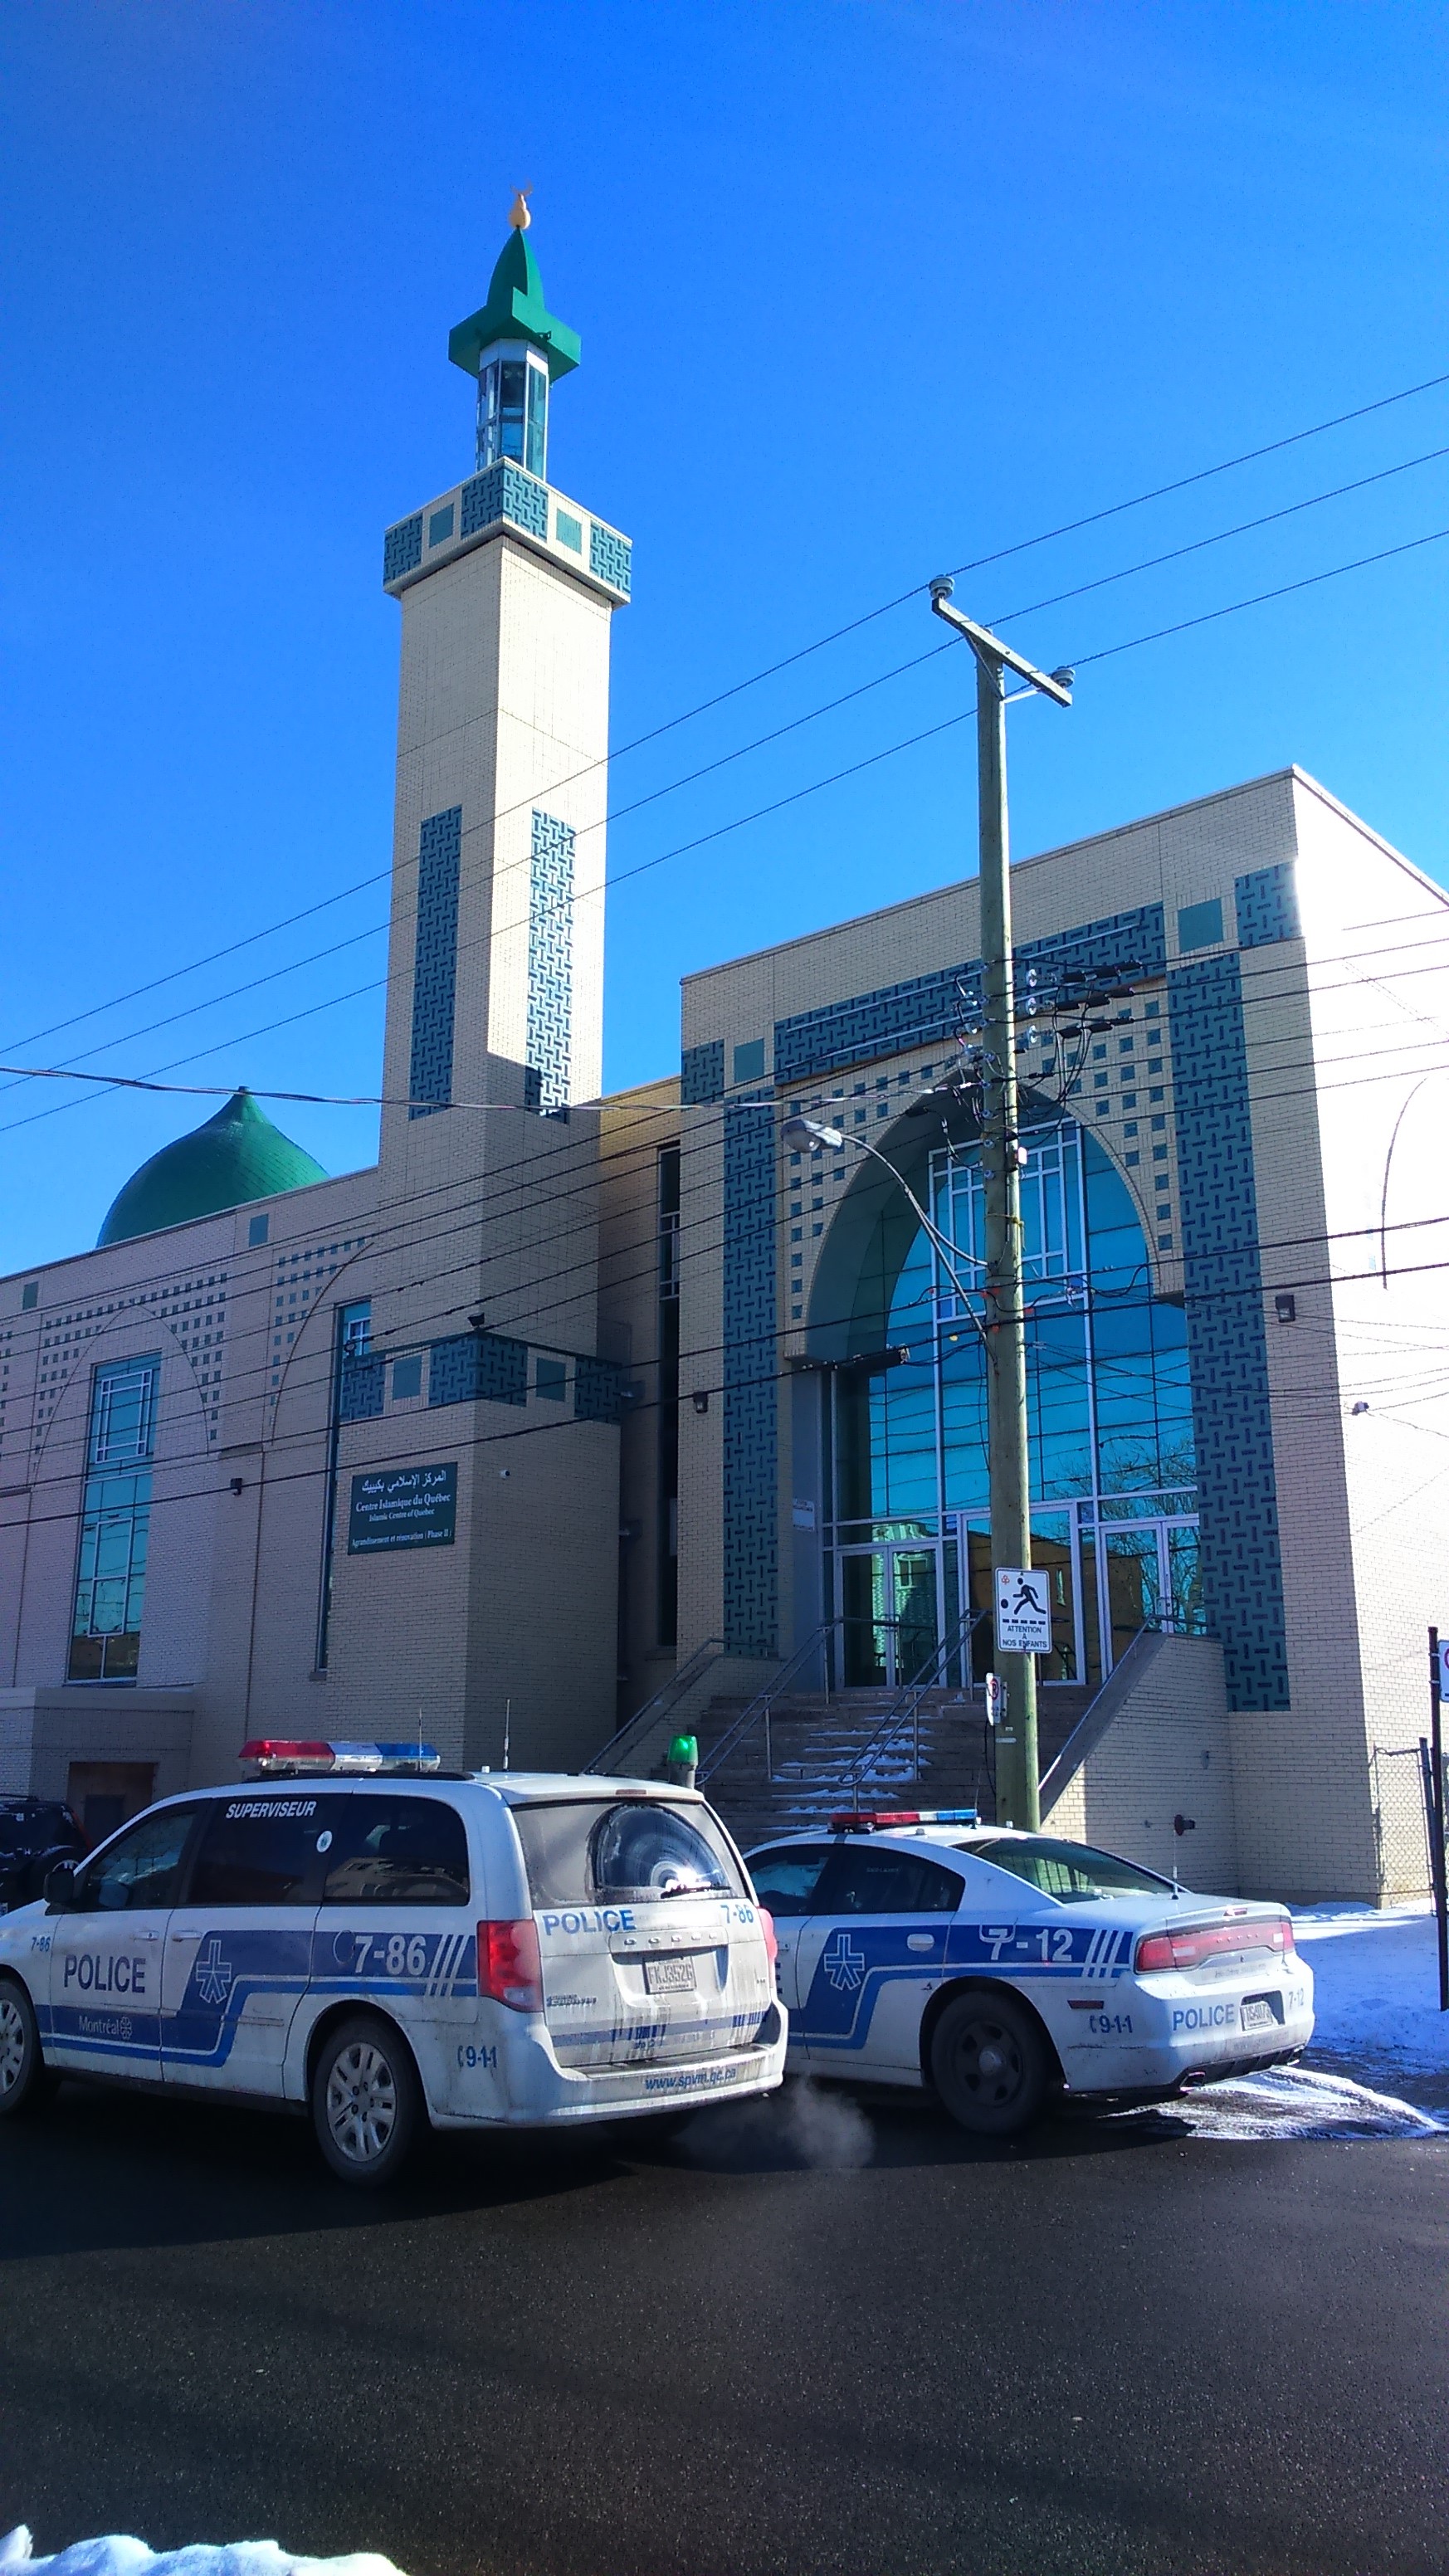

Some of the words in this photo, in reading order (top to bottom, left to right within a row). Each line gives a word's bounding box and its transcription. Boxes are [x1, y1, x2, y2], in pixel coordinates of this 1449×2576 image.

[388, 1474, 420, 1493] الإسلامي
[422, 1470, 446, 1487] المركز
[356, 1502, 378, 1512] Centre
[378, 1498, 412, 1510] Islamique
[412, 1494, 423, 1505] du
[424, 1493, 451, 1506] Québec
[369, 1513, 388, 1522] Islamic
[388, 1511, 407, 1520] Centre
[407, 1509, 414, 1517] of
[390, 1534, 396, 1543] et
[1018, 1640, 1047, 1648] ENFANTS
[225, 1801, 317, 1819] SUPERVISEUR
[542, 1910, 637, 1936] POLICE
[720, 1903, 754, 1925] 7-86
[31, 1935, 51, 1952] 7-86
[988, 1929, 1074, 1962] 7-12
[354, 1934, 427, 1976] 7-86
[64, 1954, 147, 1993] POLICE
[1288, 1988, 1305, 2011] 7-12
[79, 2015, 120, 2035] Montréal
[1100, 2015, 1134, 2033] 9-1-1
[1173, 2003, 1235, 2032] POLICE
[466, 2045, 498, 2068] 9-1-1
[645, 2067, 737, 2091] www.spvm.qc.ca
